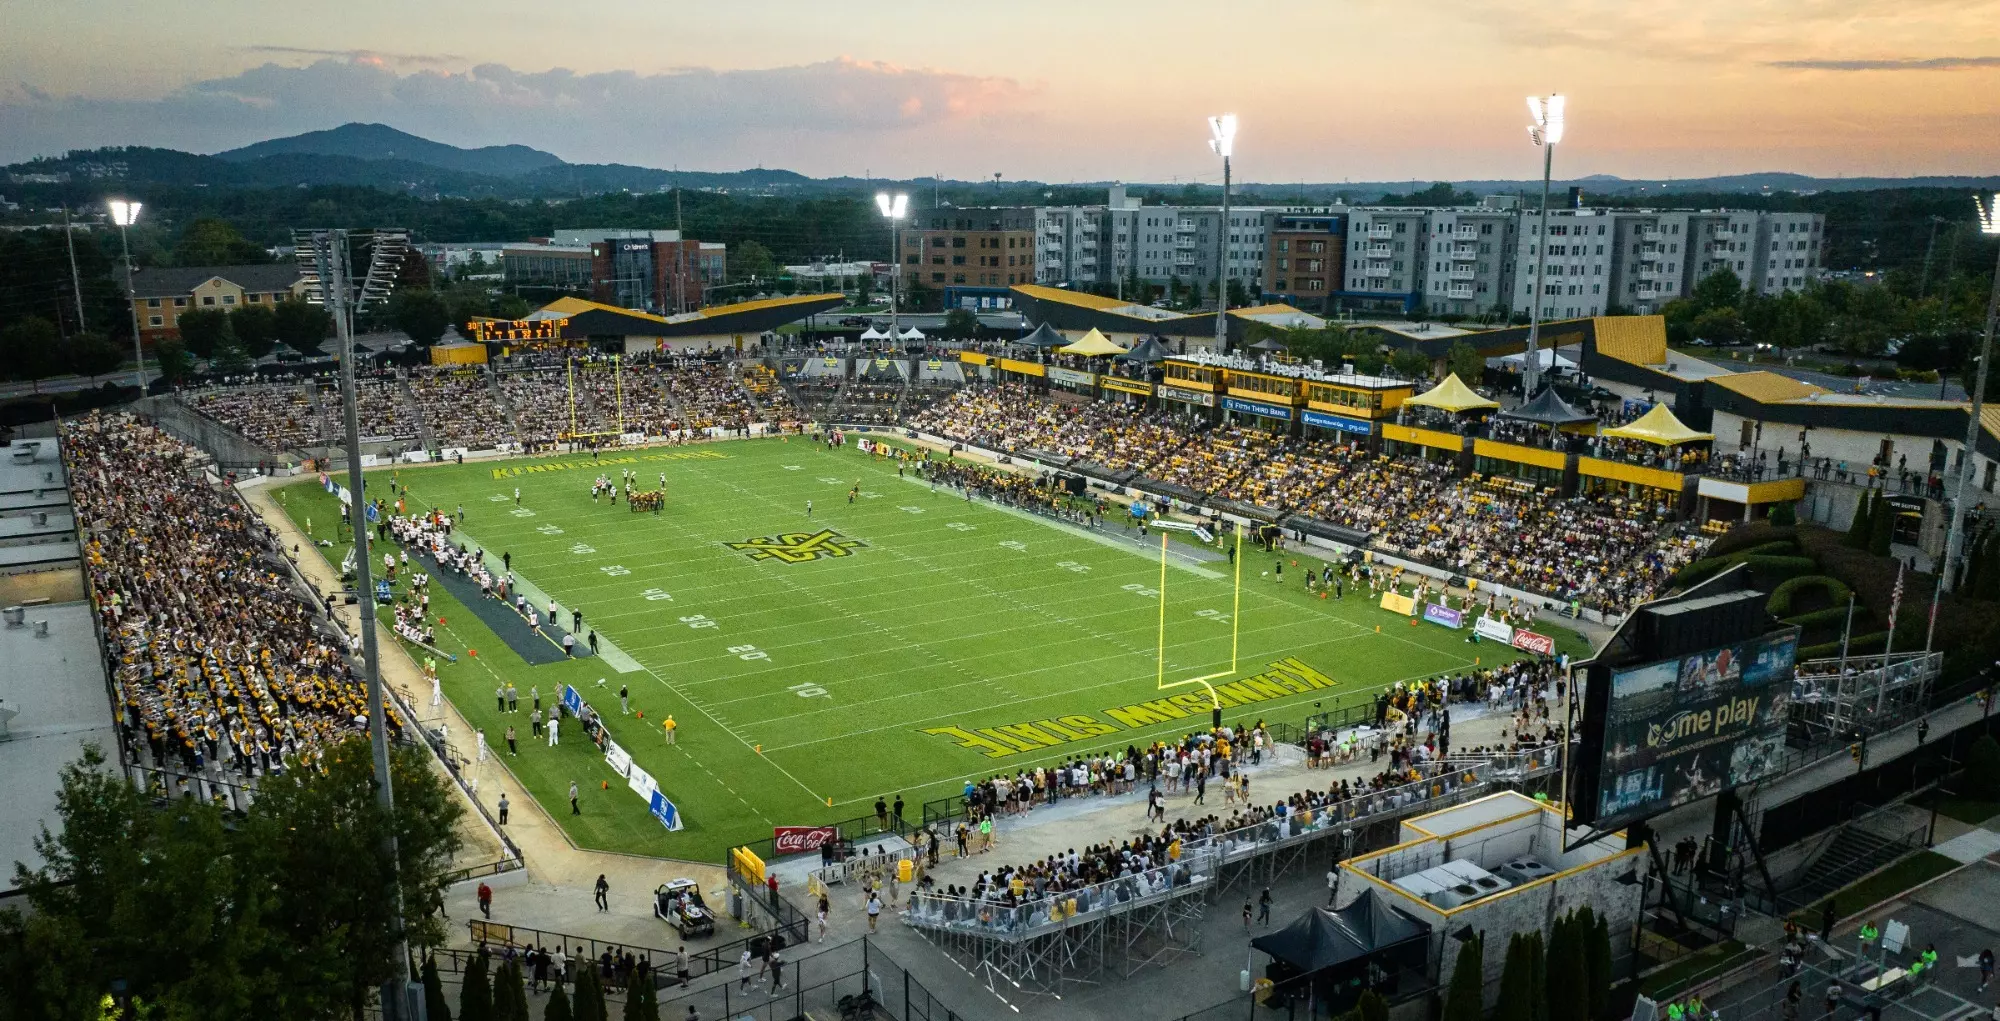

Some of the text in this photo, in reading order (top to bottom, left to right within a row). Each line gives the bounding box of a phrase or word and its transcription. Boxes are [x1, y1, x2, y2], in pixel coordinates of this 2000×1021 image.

[1235, 402, 1250, 410] FIFTH
[1252, 405, 1268, 414] THIRD
[1270, 408, 1286, 416] BANK
[1627, 453, 1638, 461] 102
[679, 614, 716, 629] 30
[727, 644, 768, 661] 20
[915, 656, 1342, 759] KENNESAW STATE
[1715, 696, 1760, 735] play
